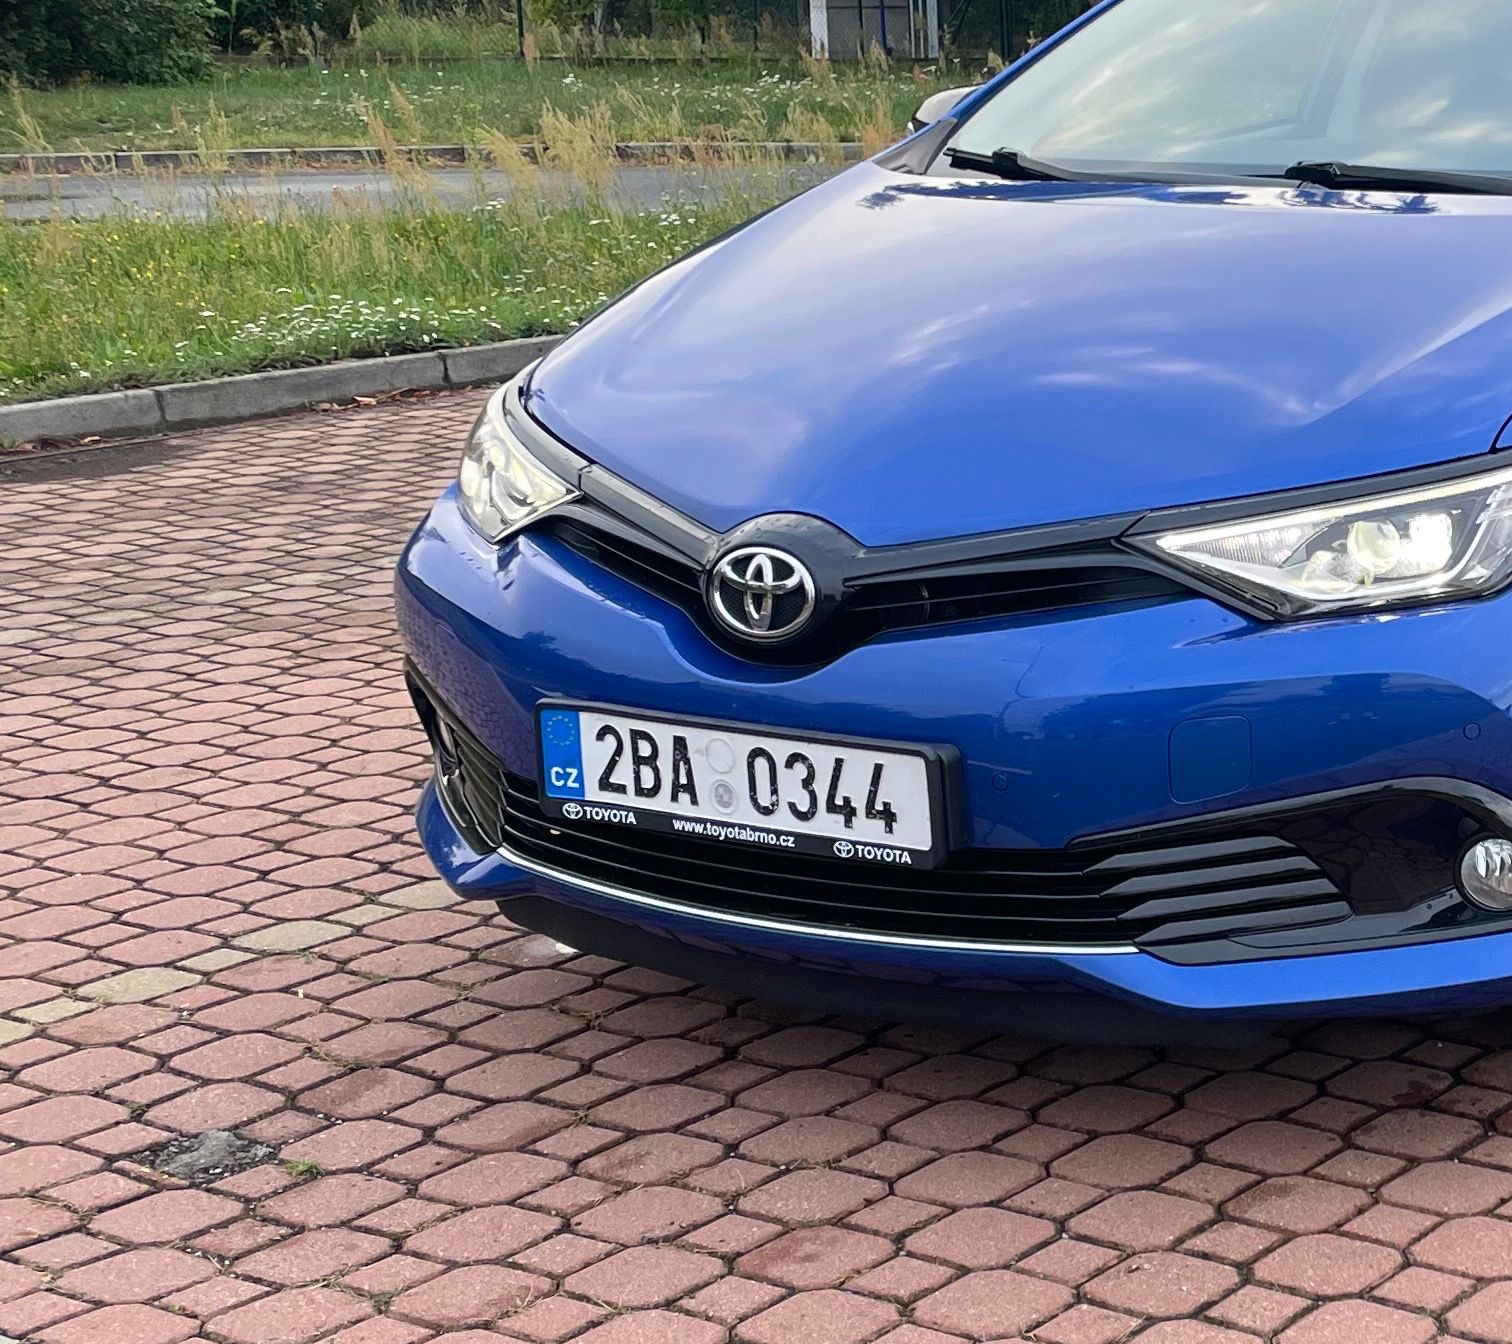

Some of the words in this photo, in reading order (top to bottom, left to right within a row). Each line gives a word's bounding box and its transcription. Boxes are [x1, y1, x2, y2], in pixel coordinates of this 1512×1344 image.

[550, 766, 580, 788] CZ
[596, 724, 699, 806] 2BA
[747, 746, 898, 834] 0344
[584, 807, 637, 825] TOYOTA
[672, 818, 795, 848] www.toyotabrno.cz
[855, 844, 912, 864] TOYOTA
